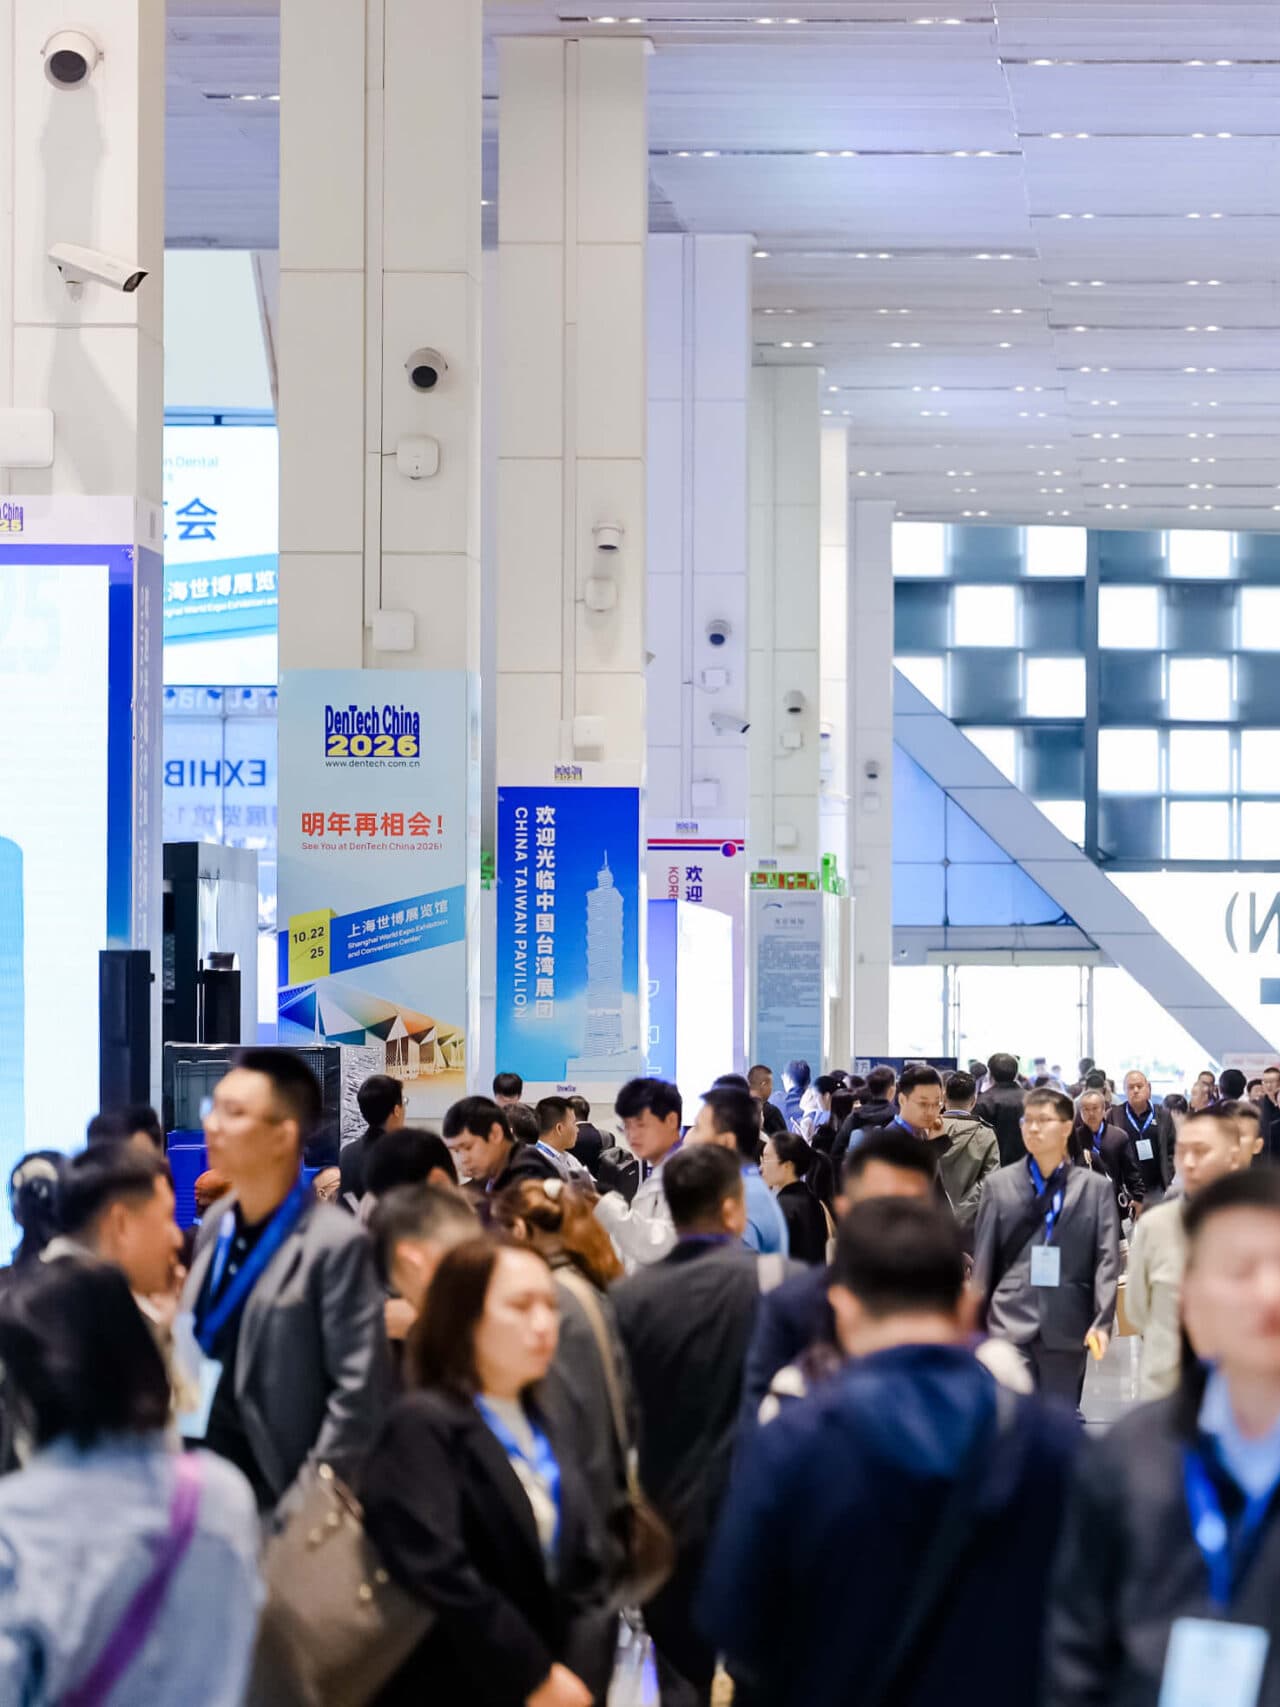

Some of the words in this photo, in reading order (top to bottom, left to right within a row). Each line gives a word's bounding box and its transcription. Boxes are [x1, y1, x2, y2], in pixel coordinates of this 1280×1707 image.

[163, 498, 217, 541] 会
[325, 704, 379, 734] DenTech
[382, 704, 420, 734] China
[327, 734, 418, 757] 2026
[325, 759, 420, 769] www.dentech.com.cn
[301, 811, 443, 837] 明年再相会！
[514, 807, 528, 862] CHINA
[302, 842, 318, 850] See
[321, 842, 337, 850] You
[350, 842, 388, 850] DenTech
[388, 842, 416, 851] China
[685, 865, 703, 902] 欢迎
[513, 867, 528, 935] TAIWAN
[535, 805, 556, 1019] 欢迎光临中国台湾展团
[347, 899, 448, 938] 上海世博展览馆
[293, 926, 325, 944] 10.22
[347, 935, 379, 950] Shanghai
[379, 930, 399, 941] World
[399, 927, 416, 937] Expo
[310, 946, 324, 960] 25
[347, 948, 360, 959] and
[360, 941, 399, 955] Convention
[513, 940, 528, 1019] PAVILION
